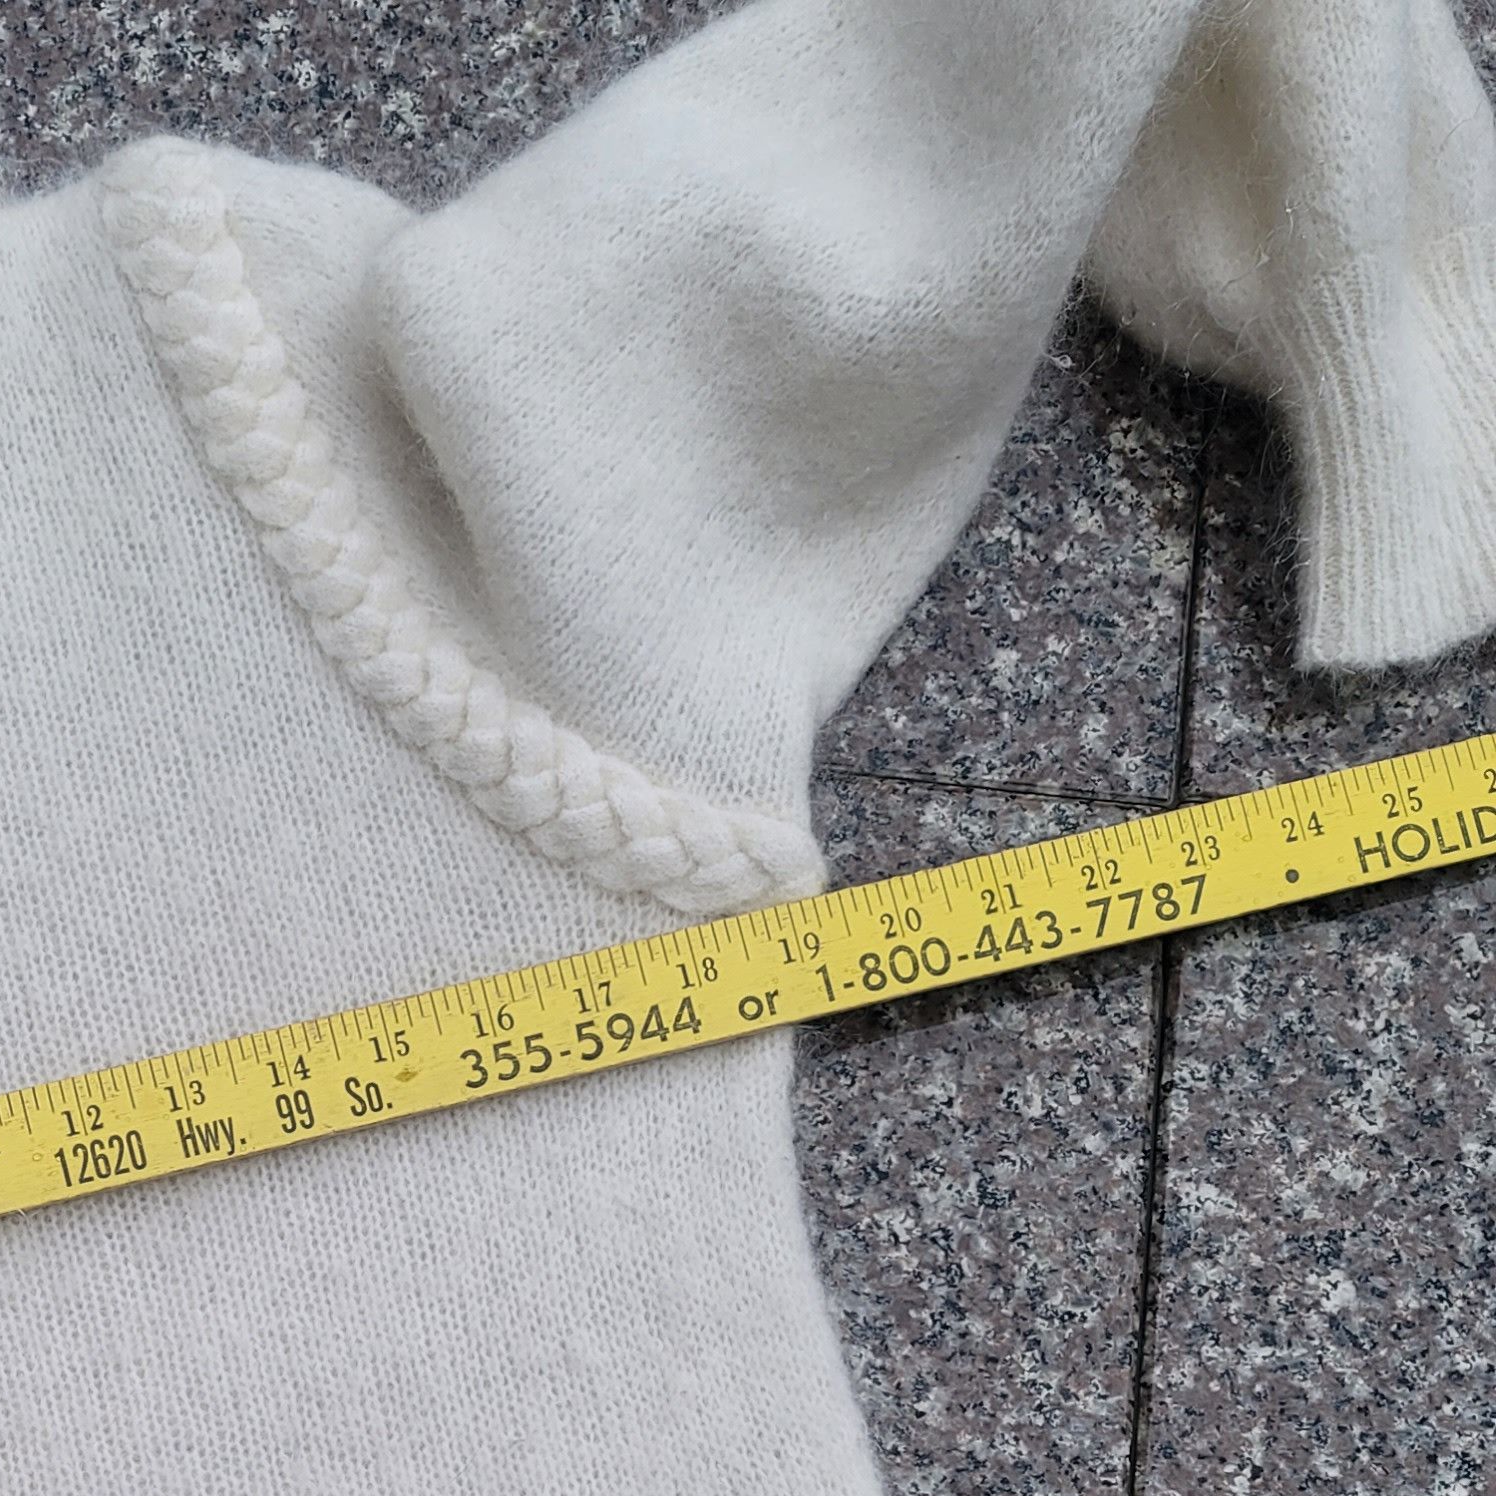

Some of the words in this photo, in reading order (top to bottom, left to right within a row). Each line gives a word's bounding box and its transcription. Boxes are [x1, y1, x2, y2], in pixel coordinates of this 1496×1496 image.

[53, 1129, 148, 1189] 12620
[175, 1115, 248, 1160] Hwy.
[274, 1088, 316, 1135] 99
[344, 1075, 394, 1118] So.
[458, 995, 703, 1090] 355-5944
[737, 988, 780, 1022] or
[814, 872, 1207, 1003] 1-800-443-7787
[60, 1103, 105, 1138] 12
[163, 1079, 207, 1114] 13
[265, 1053, 312, 1089] 14
[367, 1029, 411, 1064] 15
[469, 1003, 516, 1039] 16
[572, 979, 612, 1015] 17
[675, 955, 719, 991] 18
[777, 931, 821, 966] 19
[879, 906, 923, 941] 20
[980, 882, 1023, 917] 21
[1080, 858, 1123, 892] 22
[1179, 834, 1222, 869] 23
[1280, 810, 1326, 844] 24
[1381, 785, 1424, 820] 25
